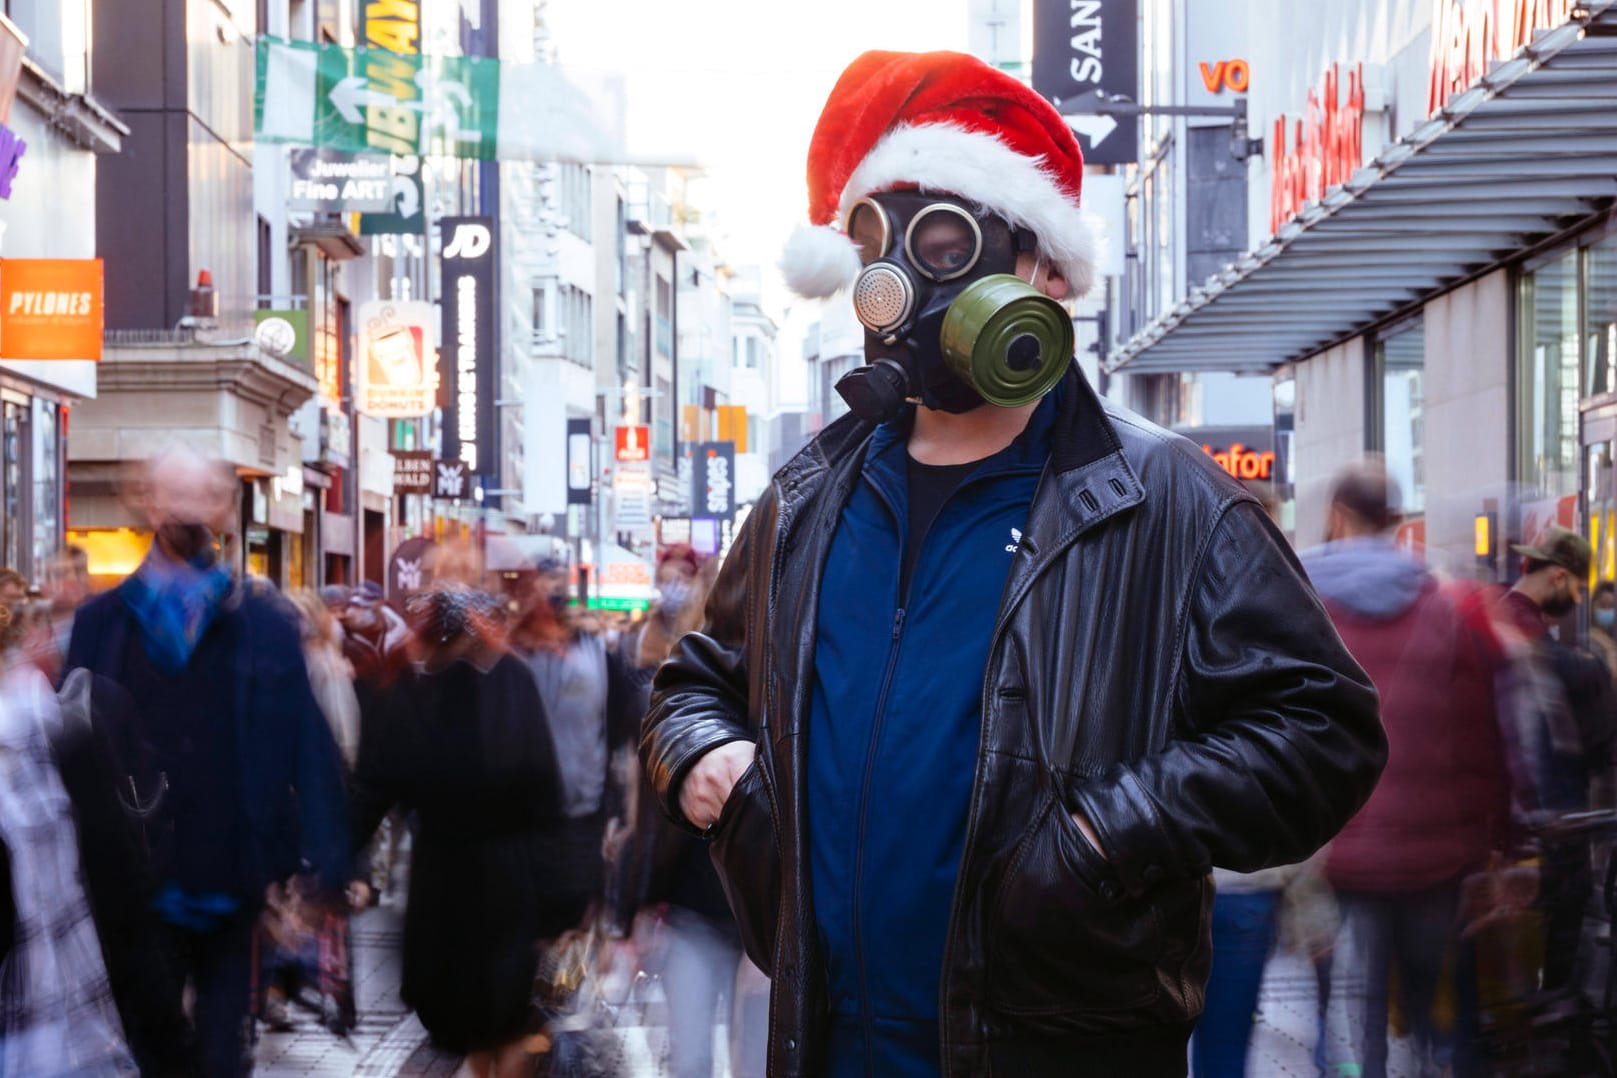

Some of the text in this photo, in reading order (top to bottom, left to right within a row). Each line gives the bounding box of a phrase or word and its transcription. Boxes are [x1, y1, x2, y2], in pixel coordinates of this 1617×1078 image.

[293, 179, 387, 200] Fine ART
[443, 224, 491, 258] JD
[9, 292, 92, 315] PYLONES
[396, 459, 431, 472] LBEN
